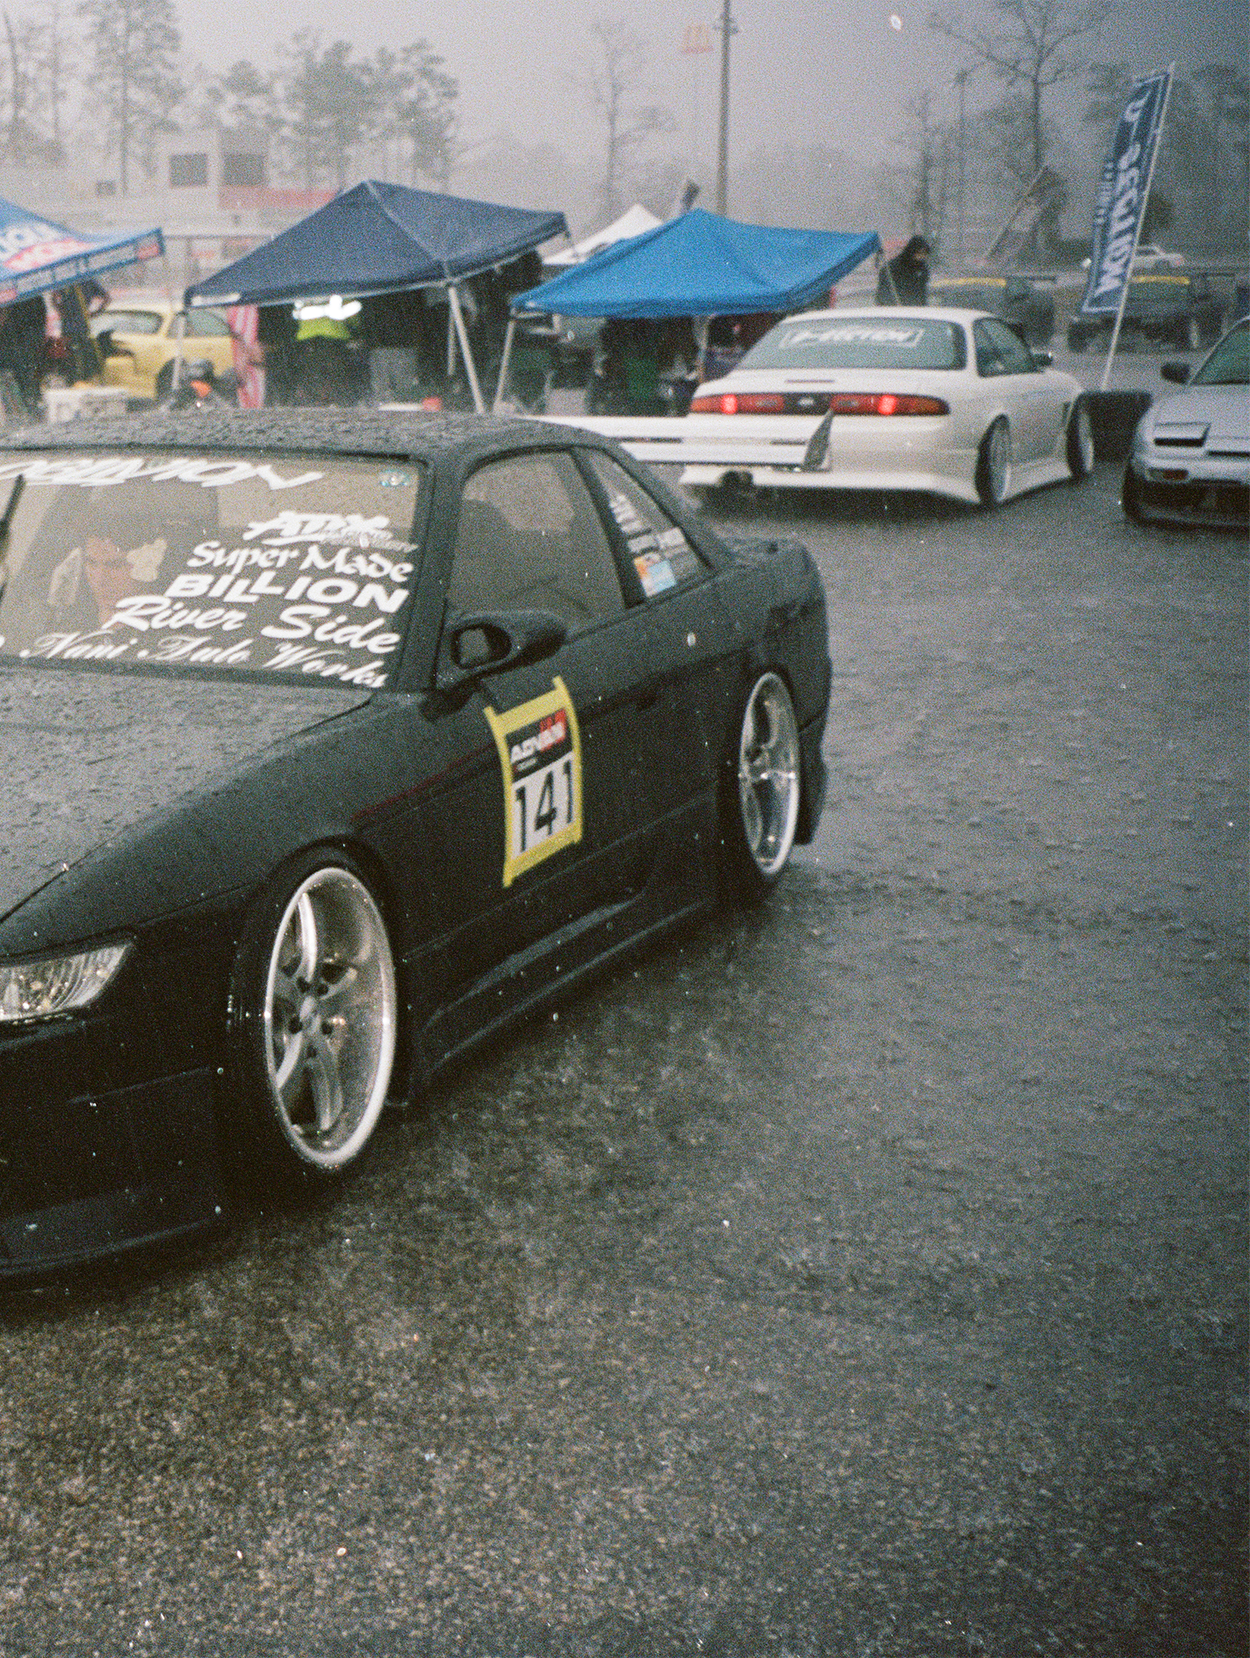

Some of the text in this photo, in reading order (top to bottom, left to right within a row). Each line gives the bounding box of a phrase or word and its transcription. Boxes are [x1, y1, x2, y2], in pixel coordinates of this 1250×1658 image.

[186, 538, 299, 575] Super
[299, 544, 414, 582] Made
[164, 570, 409, 613] BILLION
[102, 594, 402, 654] River Side
[261, 642, 390, 689] Works
[515, 759, 573, 853] 141
